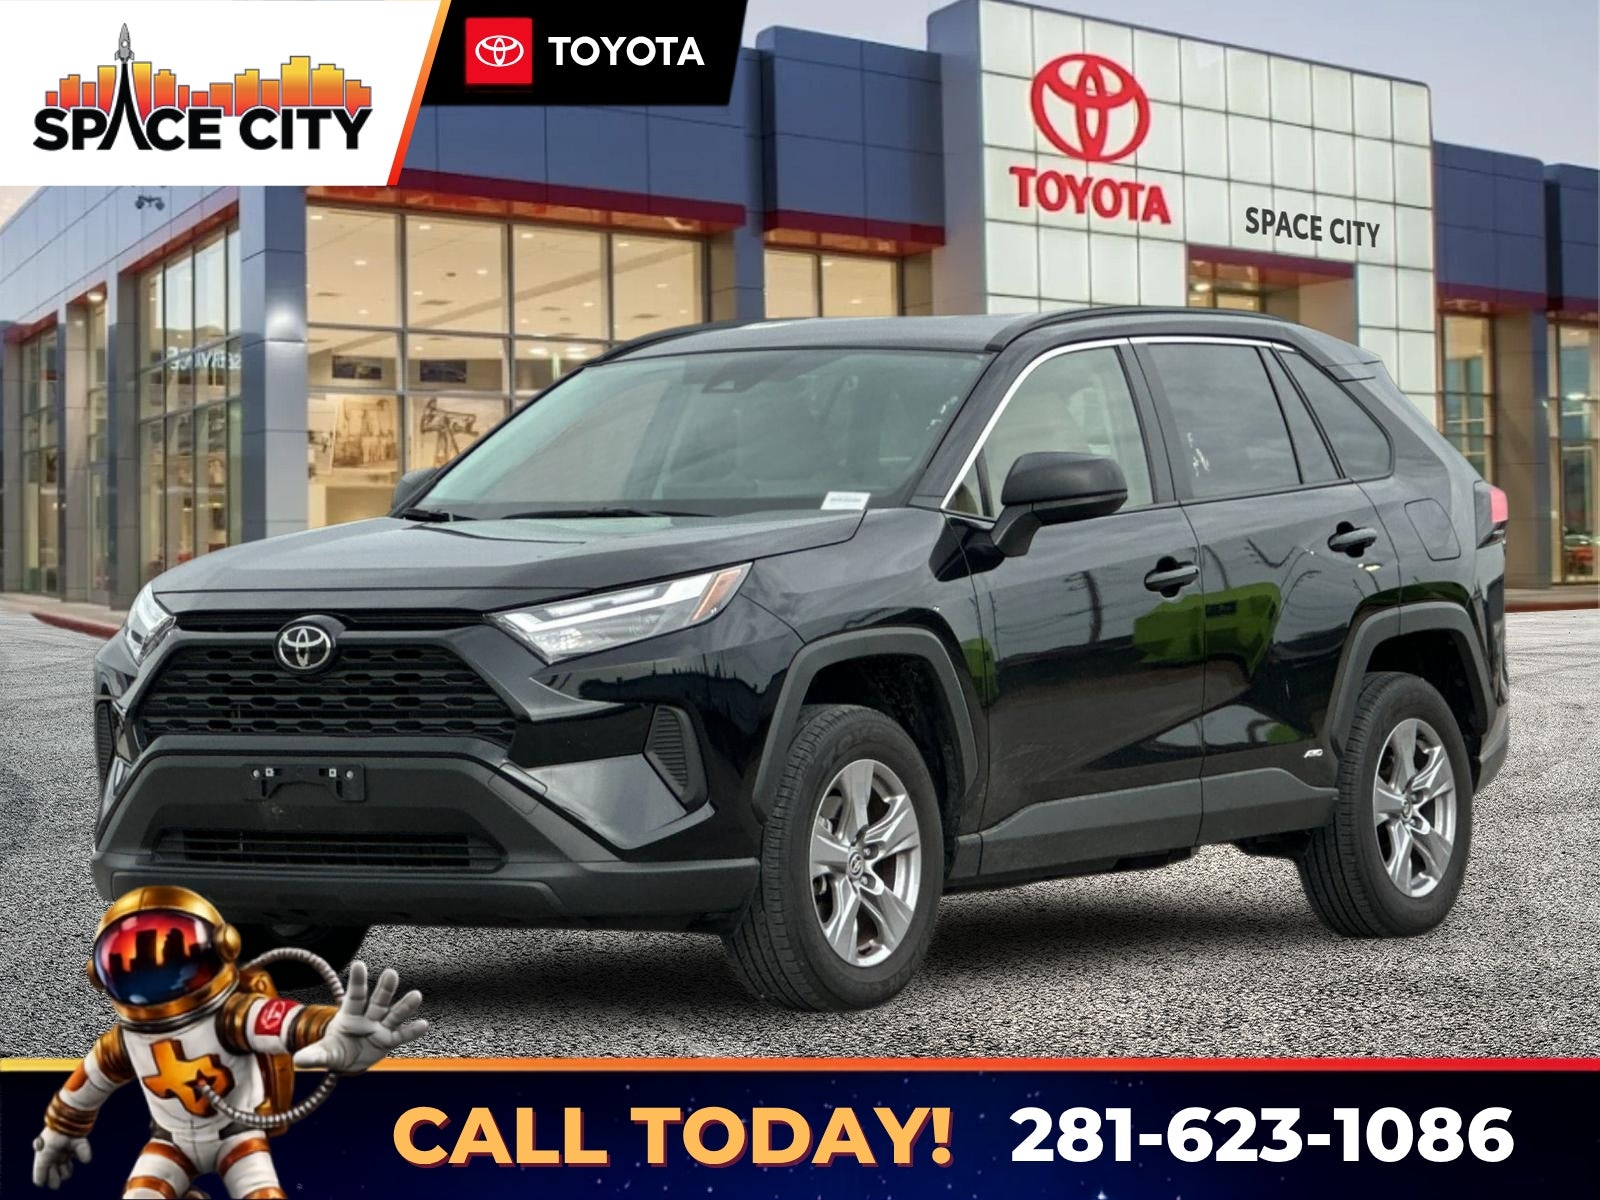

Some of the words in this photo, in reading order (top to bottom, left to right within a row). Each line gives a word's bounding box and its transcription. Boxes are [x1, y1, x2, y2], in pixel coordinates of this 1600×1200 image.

[1009, 166, 1171, 225] TOYOTA
[1245, 207, 1322, 242] SPACE
[1330, 218, 1380, 248] CITY
